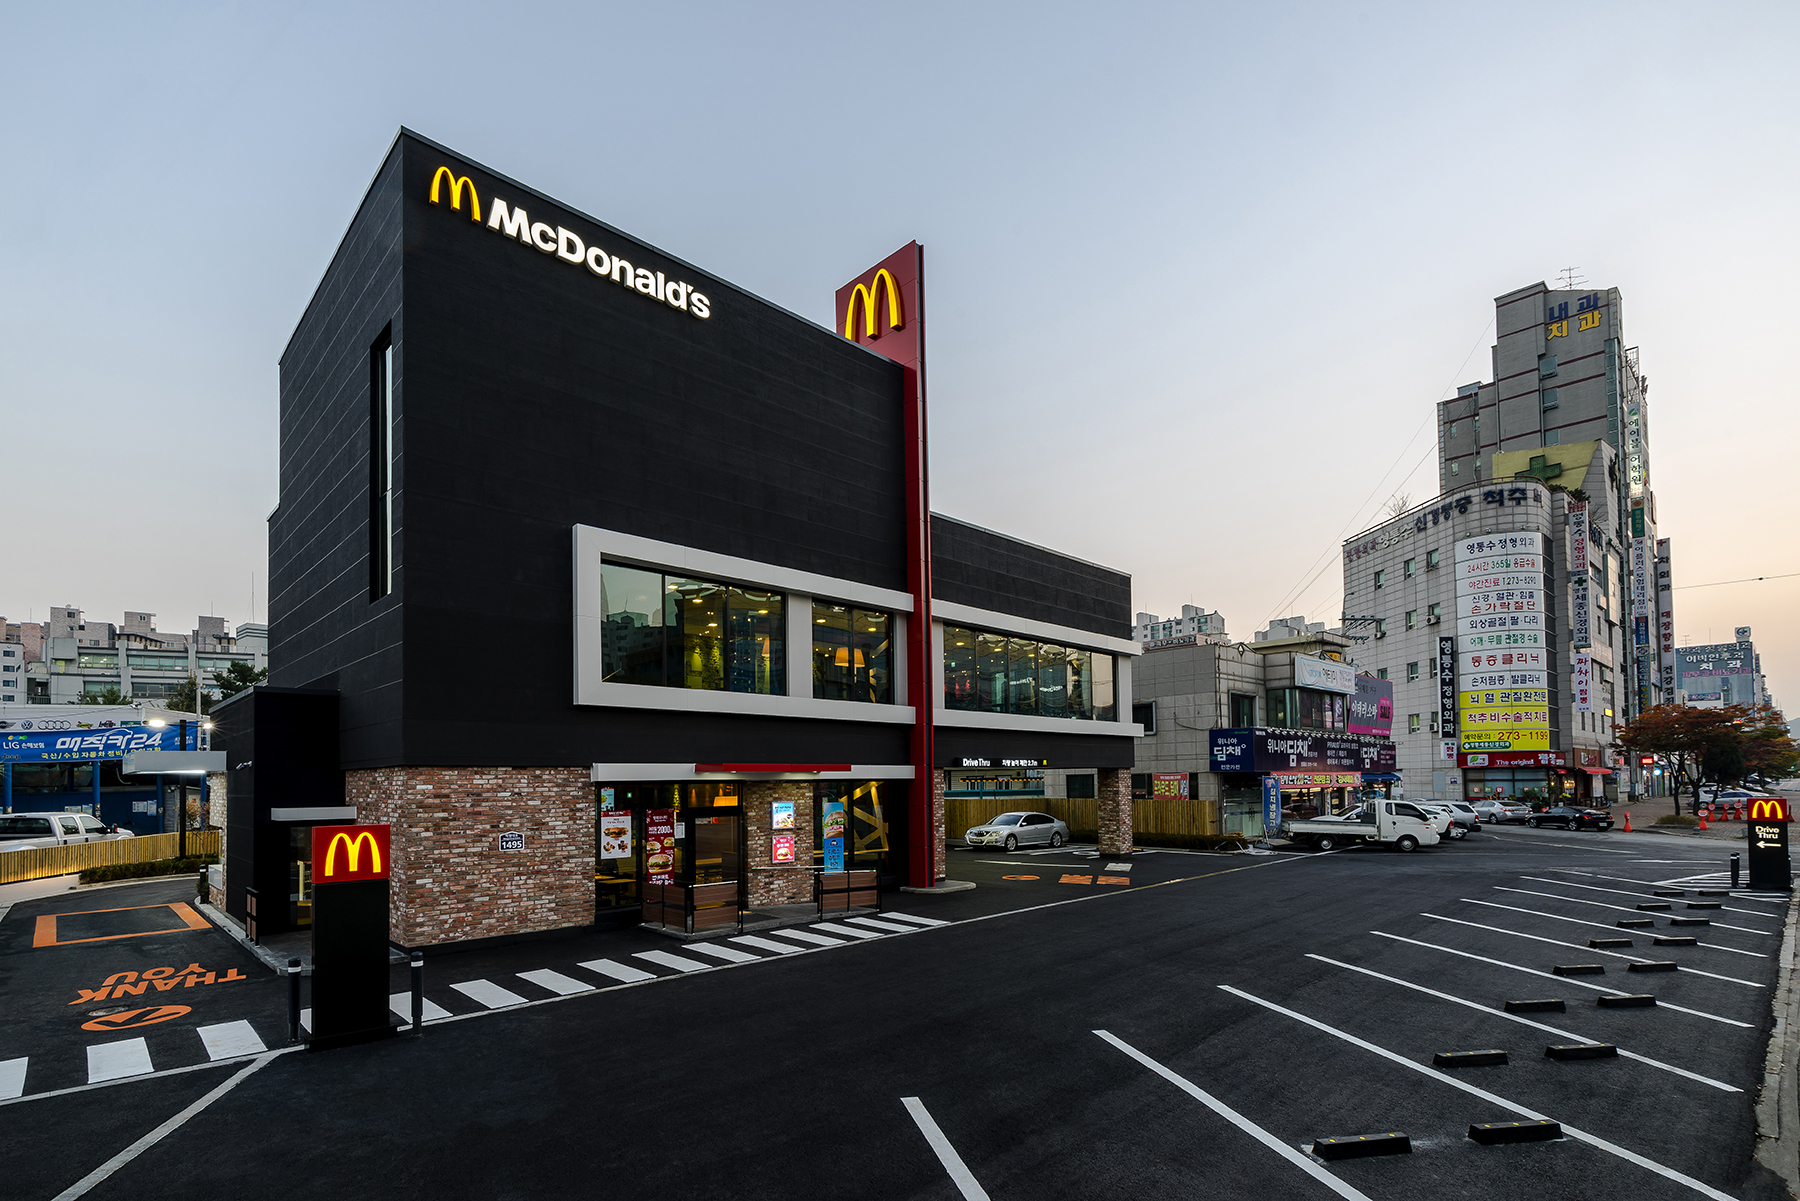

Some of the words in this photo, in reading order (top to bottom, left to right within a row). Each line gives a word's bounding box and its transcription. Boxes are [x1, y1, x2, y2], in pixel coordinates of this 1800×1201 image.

[486, 197, 711, 319] McDonald's
[1548, 292, 1600, 322] 내과
[1546, 310, 1602, 341] 치과
[1482, 486, 1529, 508] 척추
[1471, 601, 1536, 615] 손가락절단
[1661, 610, 1673, 653] 대장항문
[1700, 660, 1742, 670] 치과
[1380, 705, 1391, 719] SALE
[1467, 711, 1548, 724] 척추비수술적치료
[1497, 731, 1549, 741] 273-1199
[963, 758, 978, 766] Drive
[978, 758, 990, 766] Thru
[502, 841, 522, 849] 1495
[101, 963, 207, 986] YOU
[68, 968, 247, 1005] THANK
